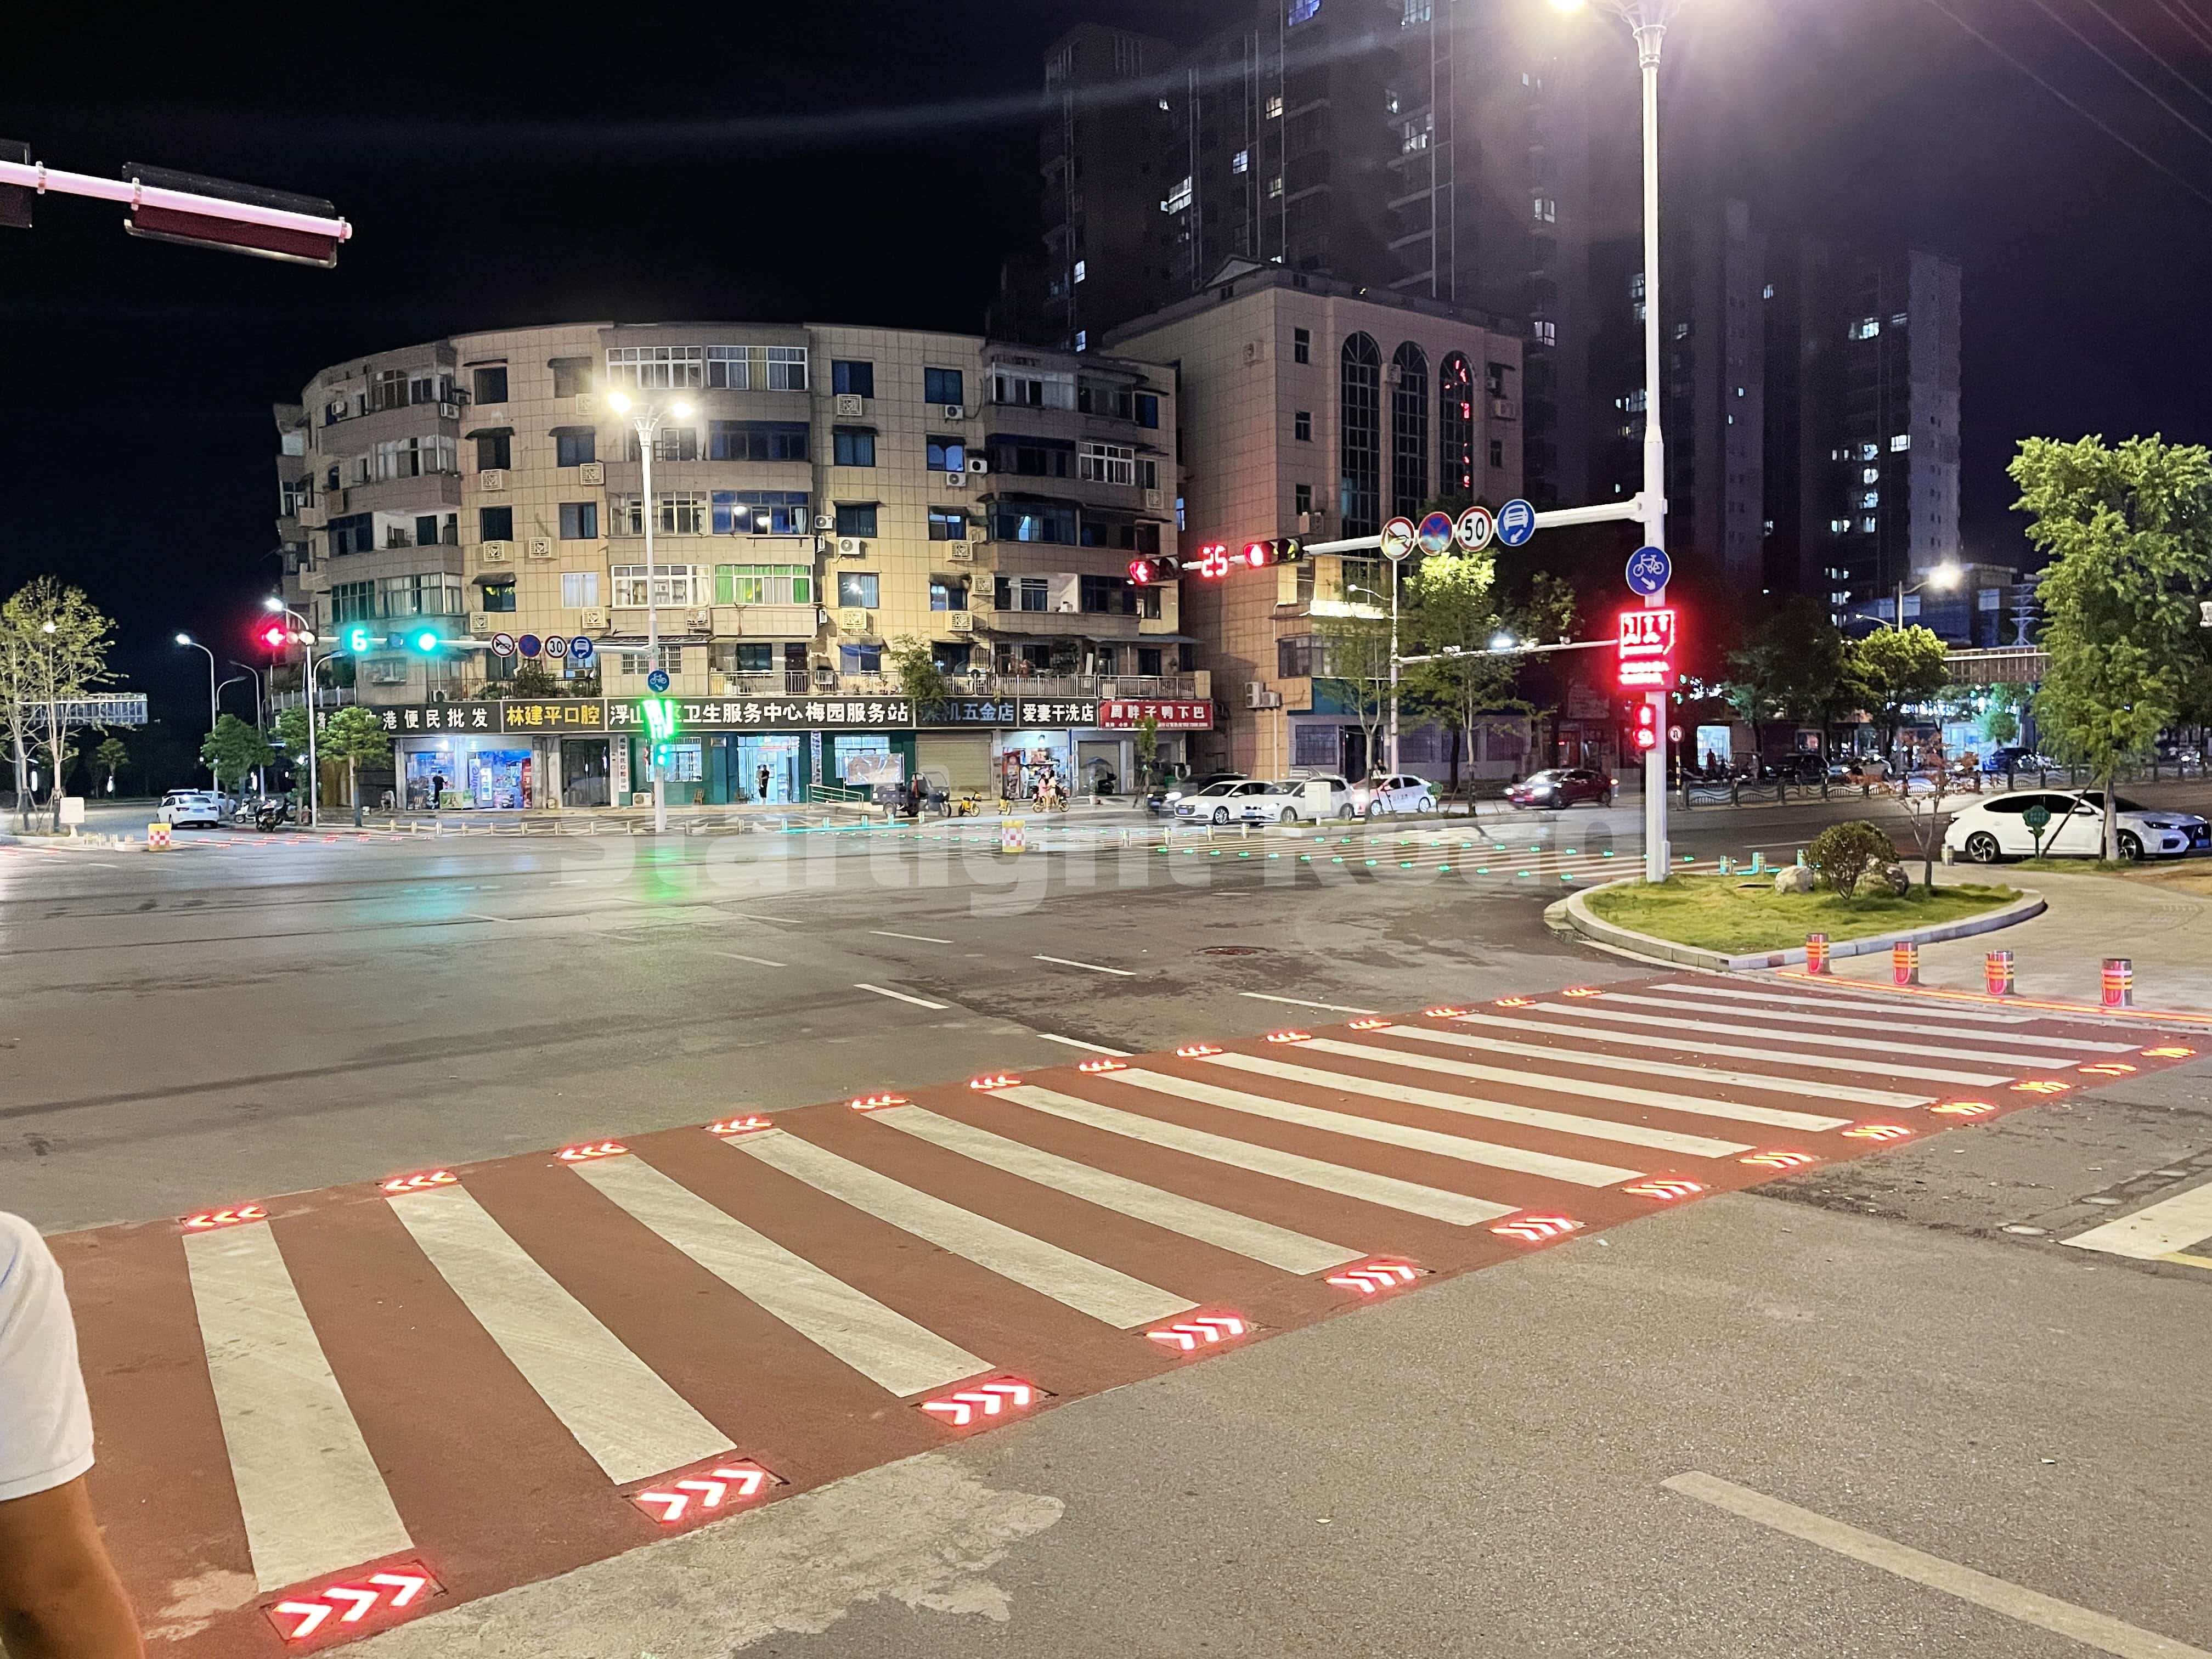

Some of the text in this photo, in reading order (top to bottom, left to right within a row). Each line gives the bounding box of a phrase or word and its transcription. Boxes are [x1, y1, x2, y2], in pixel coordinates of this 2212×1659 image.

[1465, 517, 1485, 541] 50
[1201, 544, 1228, 577] 25
[352, 629, 367, 652] 6
[550, 640, 562, 653] 30
[506, 705, 600, 726] 林建平口腔
[610, 702, 909, 725] 浮山区卫生服务中心梅园服务站
[1023, 703, 1094, 722] 爱妻干洗店
